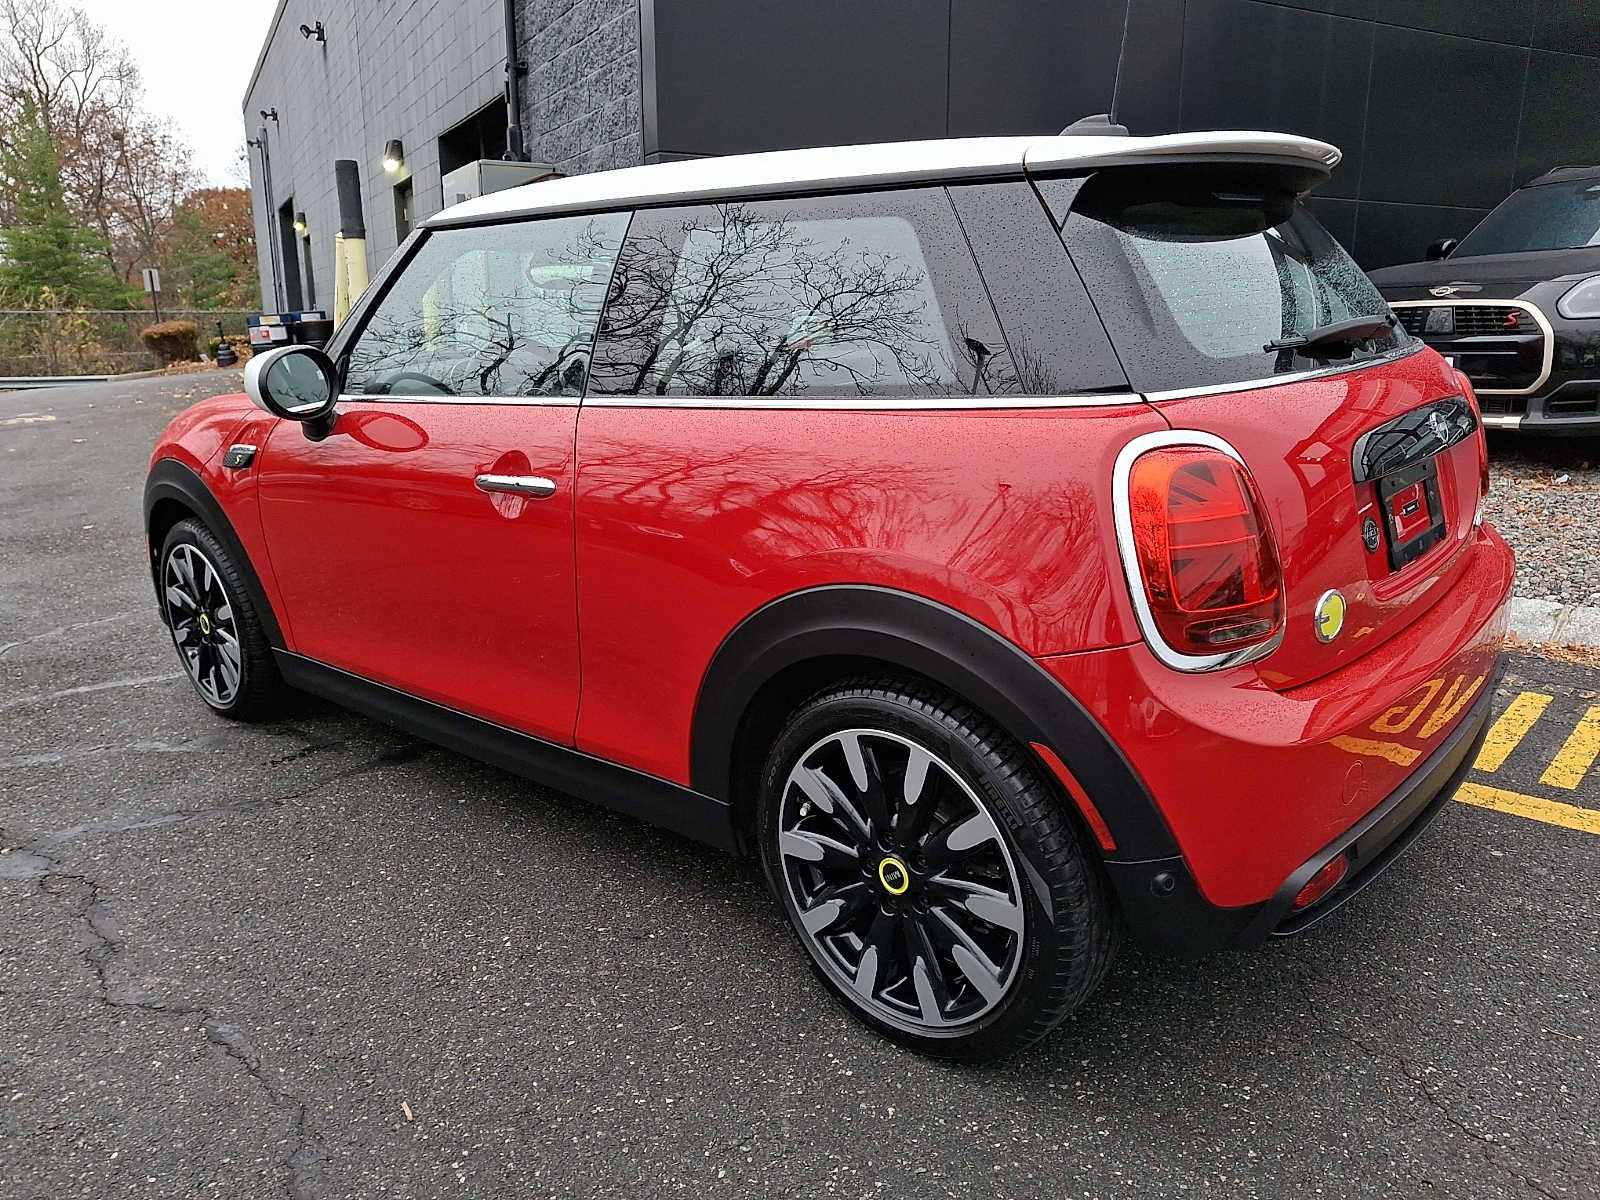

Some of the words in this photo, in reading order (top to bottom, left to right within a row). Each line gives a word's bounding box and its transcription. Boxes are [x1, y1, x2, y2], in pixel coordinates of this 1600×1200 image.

[1502, 311, 1521, 328] S
[978, 775, 1018, 830] PIRELLI
[884, 870, 901, 882] MINI
